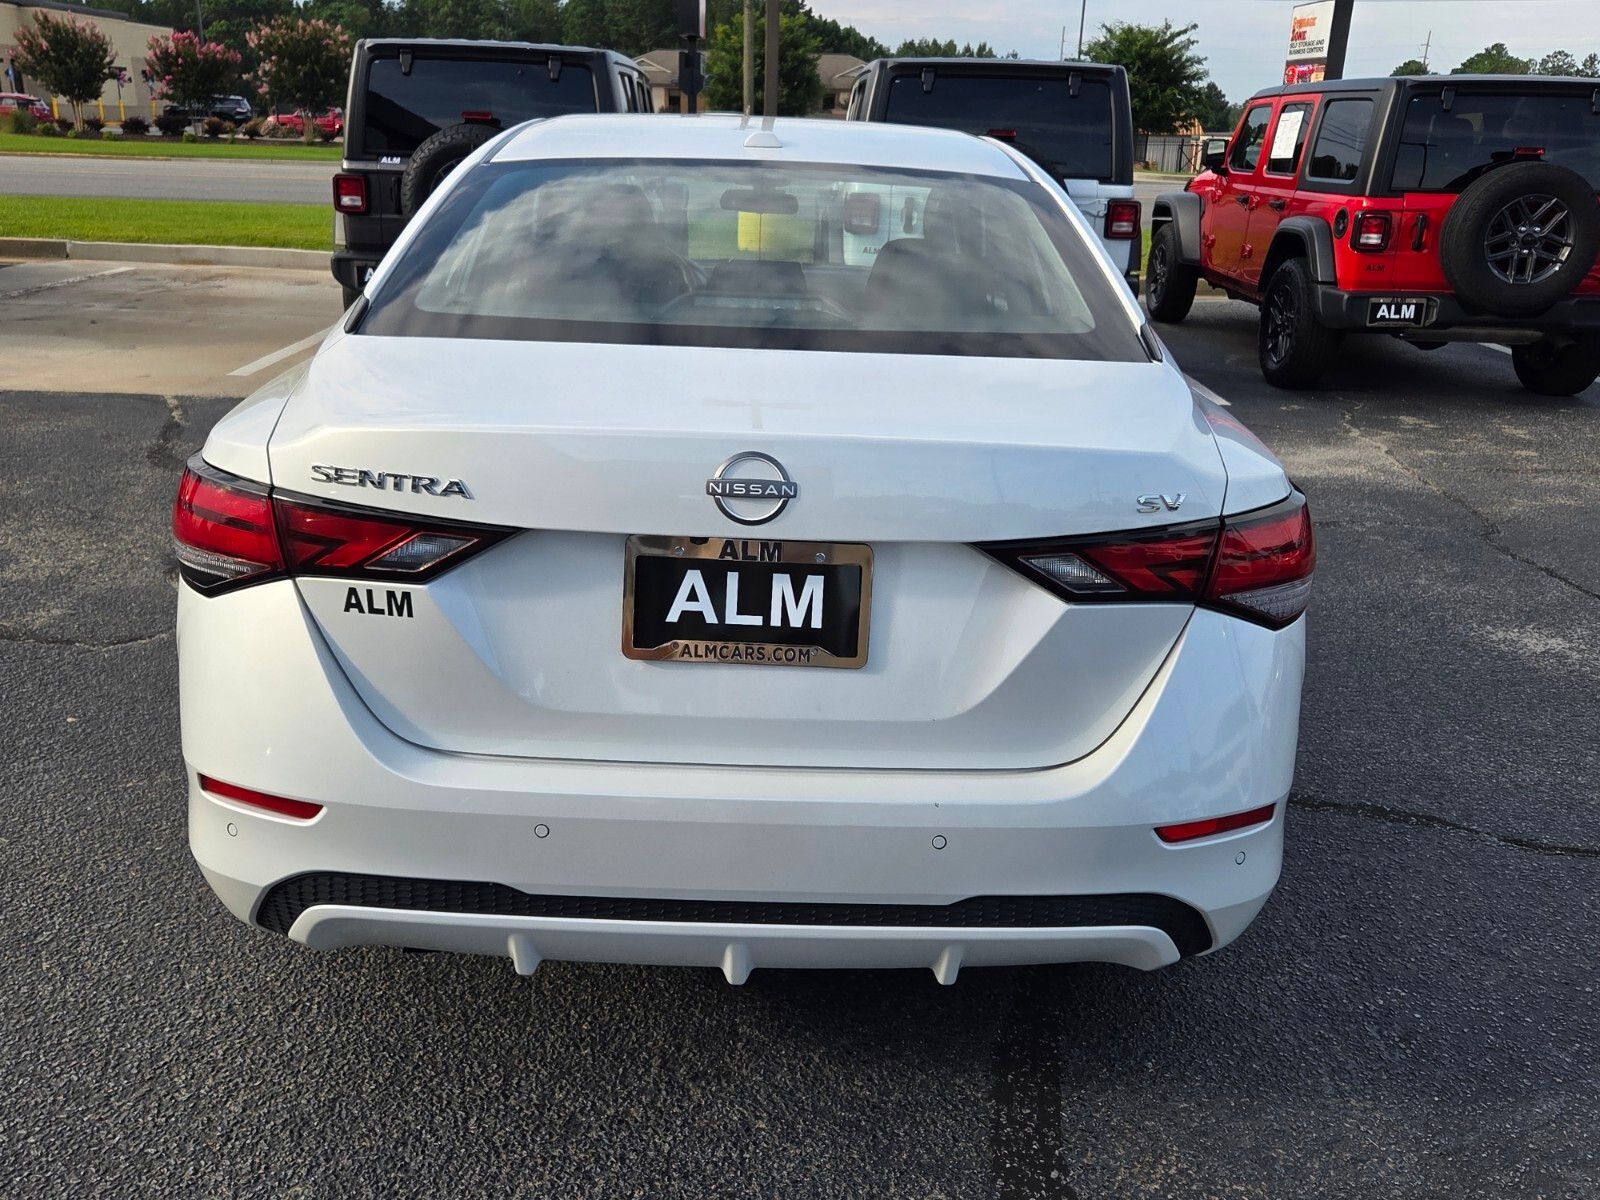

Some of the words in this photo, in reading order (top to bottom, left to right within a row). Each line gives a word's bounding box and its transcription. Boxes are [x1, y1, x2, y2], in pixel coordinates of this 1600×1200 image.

[380, 156, 401, 164] ALM
[1376, 304, 1416, 319] ALM
[311, 464, 475, 500] SENTRA
[708, 481, 796, 496] NISSAN
[1136, 494, 1187, 513] SV
[718, 539, 783, 563] ALM
[343, 586, 414, 618] ALM
[665, 569, 825, 629] ALM
[679, 643, 812, 663] ALMCARS.COM
